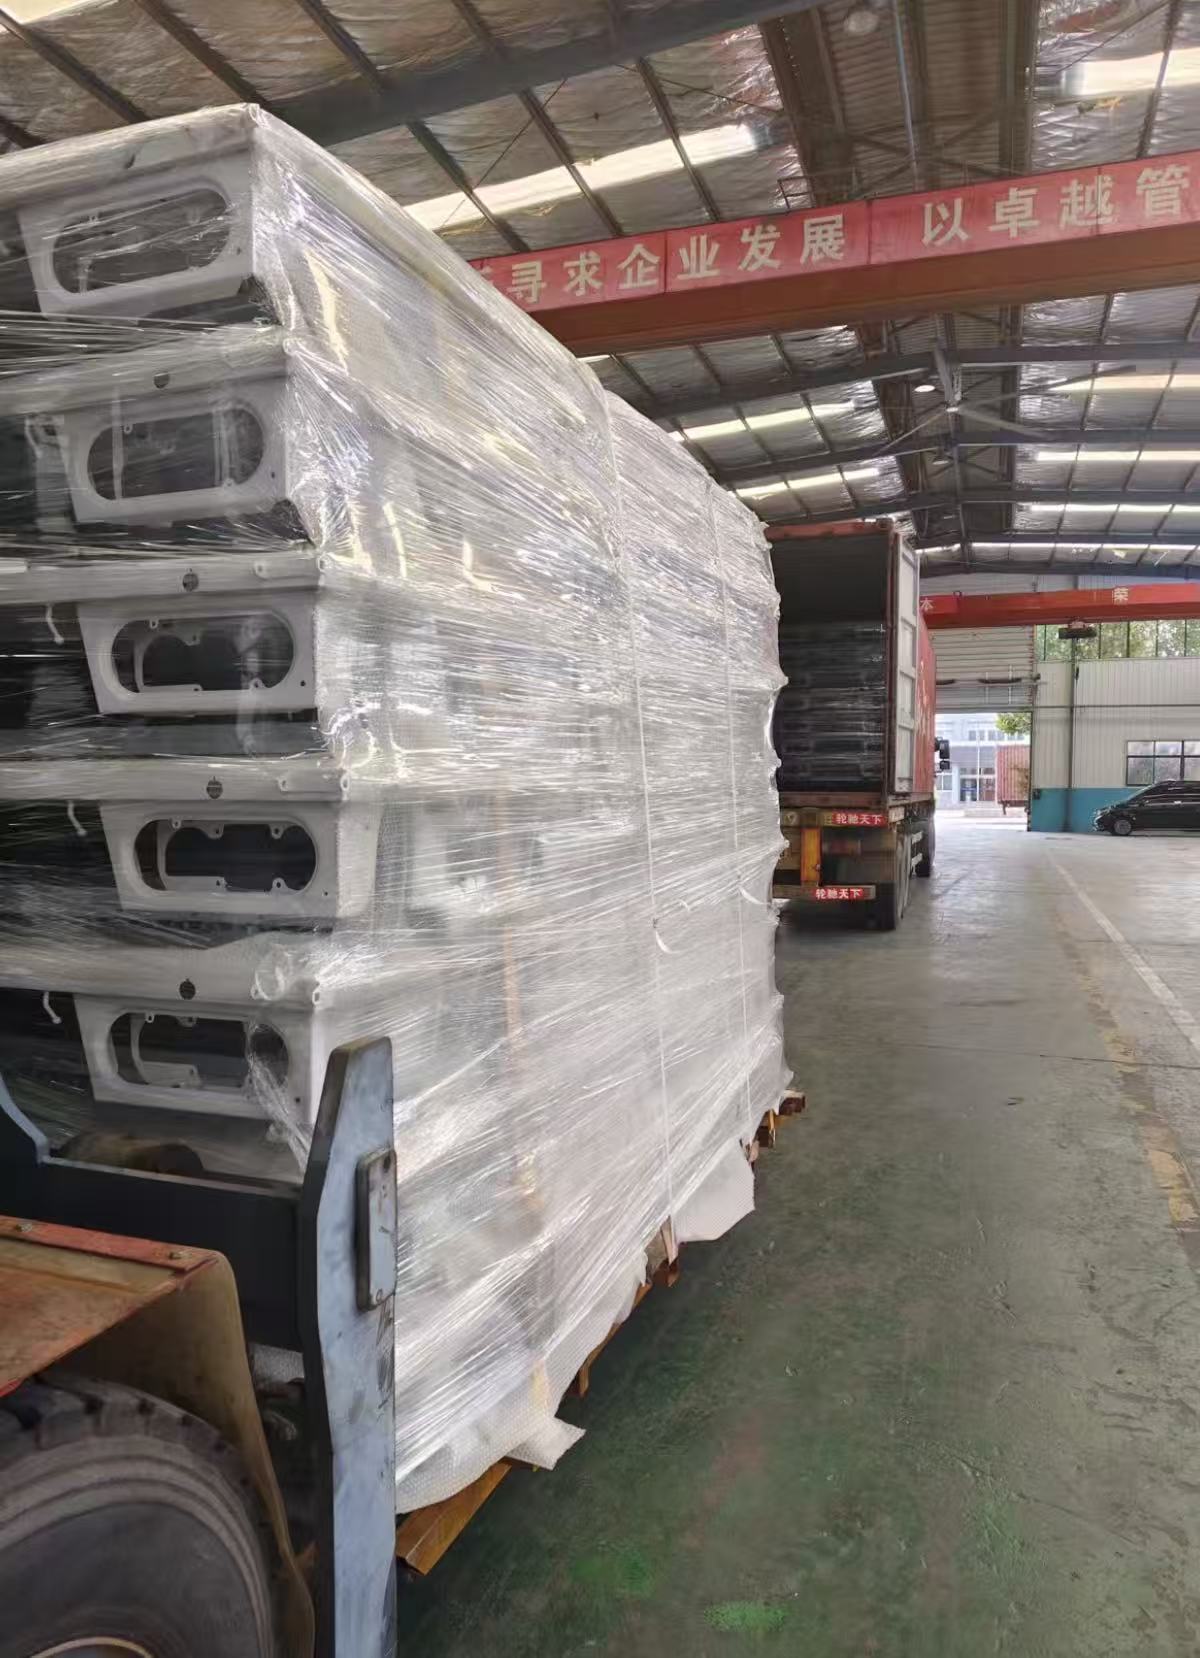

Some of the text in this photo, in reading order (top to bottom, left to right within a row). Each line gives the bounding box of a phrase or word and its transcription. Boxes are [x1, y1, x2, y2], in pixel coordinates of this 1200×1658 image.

[481, 164, 1190, 304] 寻求企业发展 以卓越管
